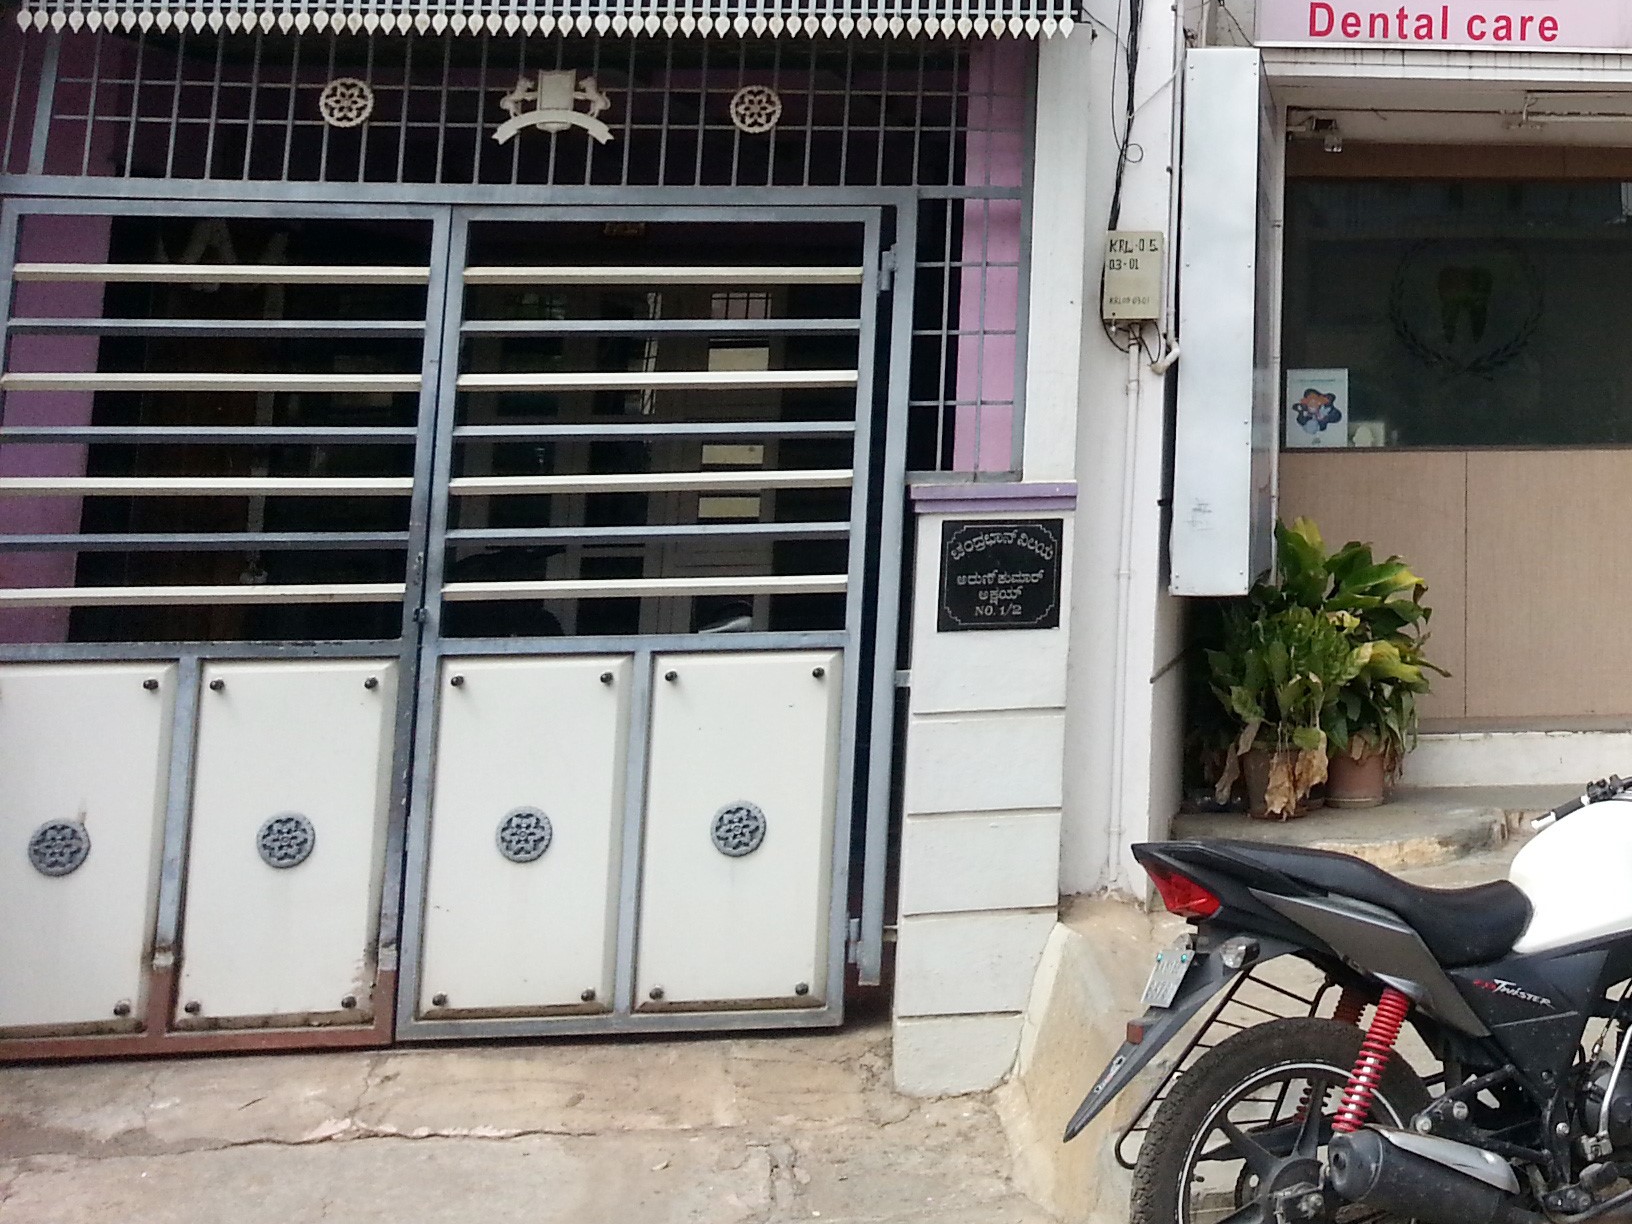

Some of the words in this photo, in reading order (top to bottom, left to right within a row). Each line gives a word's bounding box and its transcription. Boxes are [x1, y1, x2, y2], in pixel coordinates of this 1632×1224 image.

[1308, 1, 1449, 40] Dental
[1466, 14, 1560, 42] care
[974, 605, 996, 616] NO.
